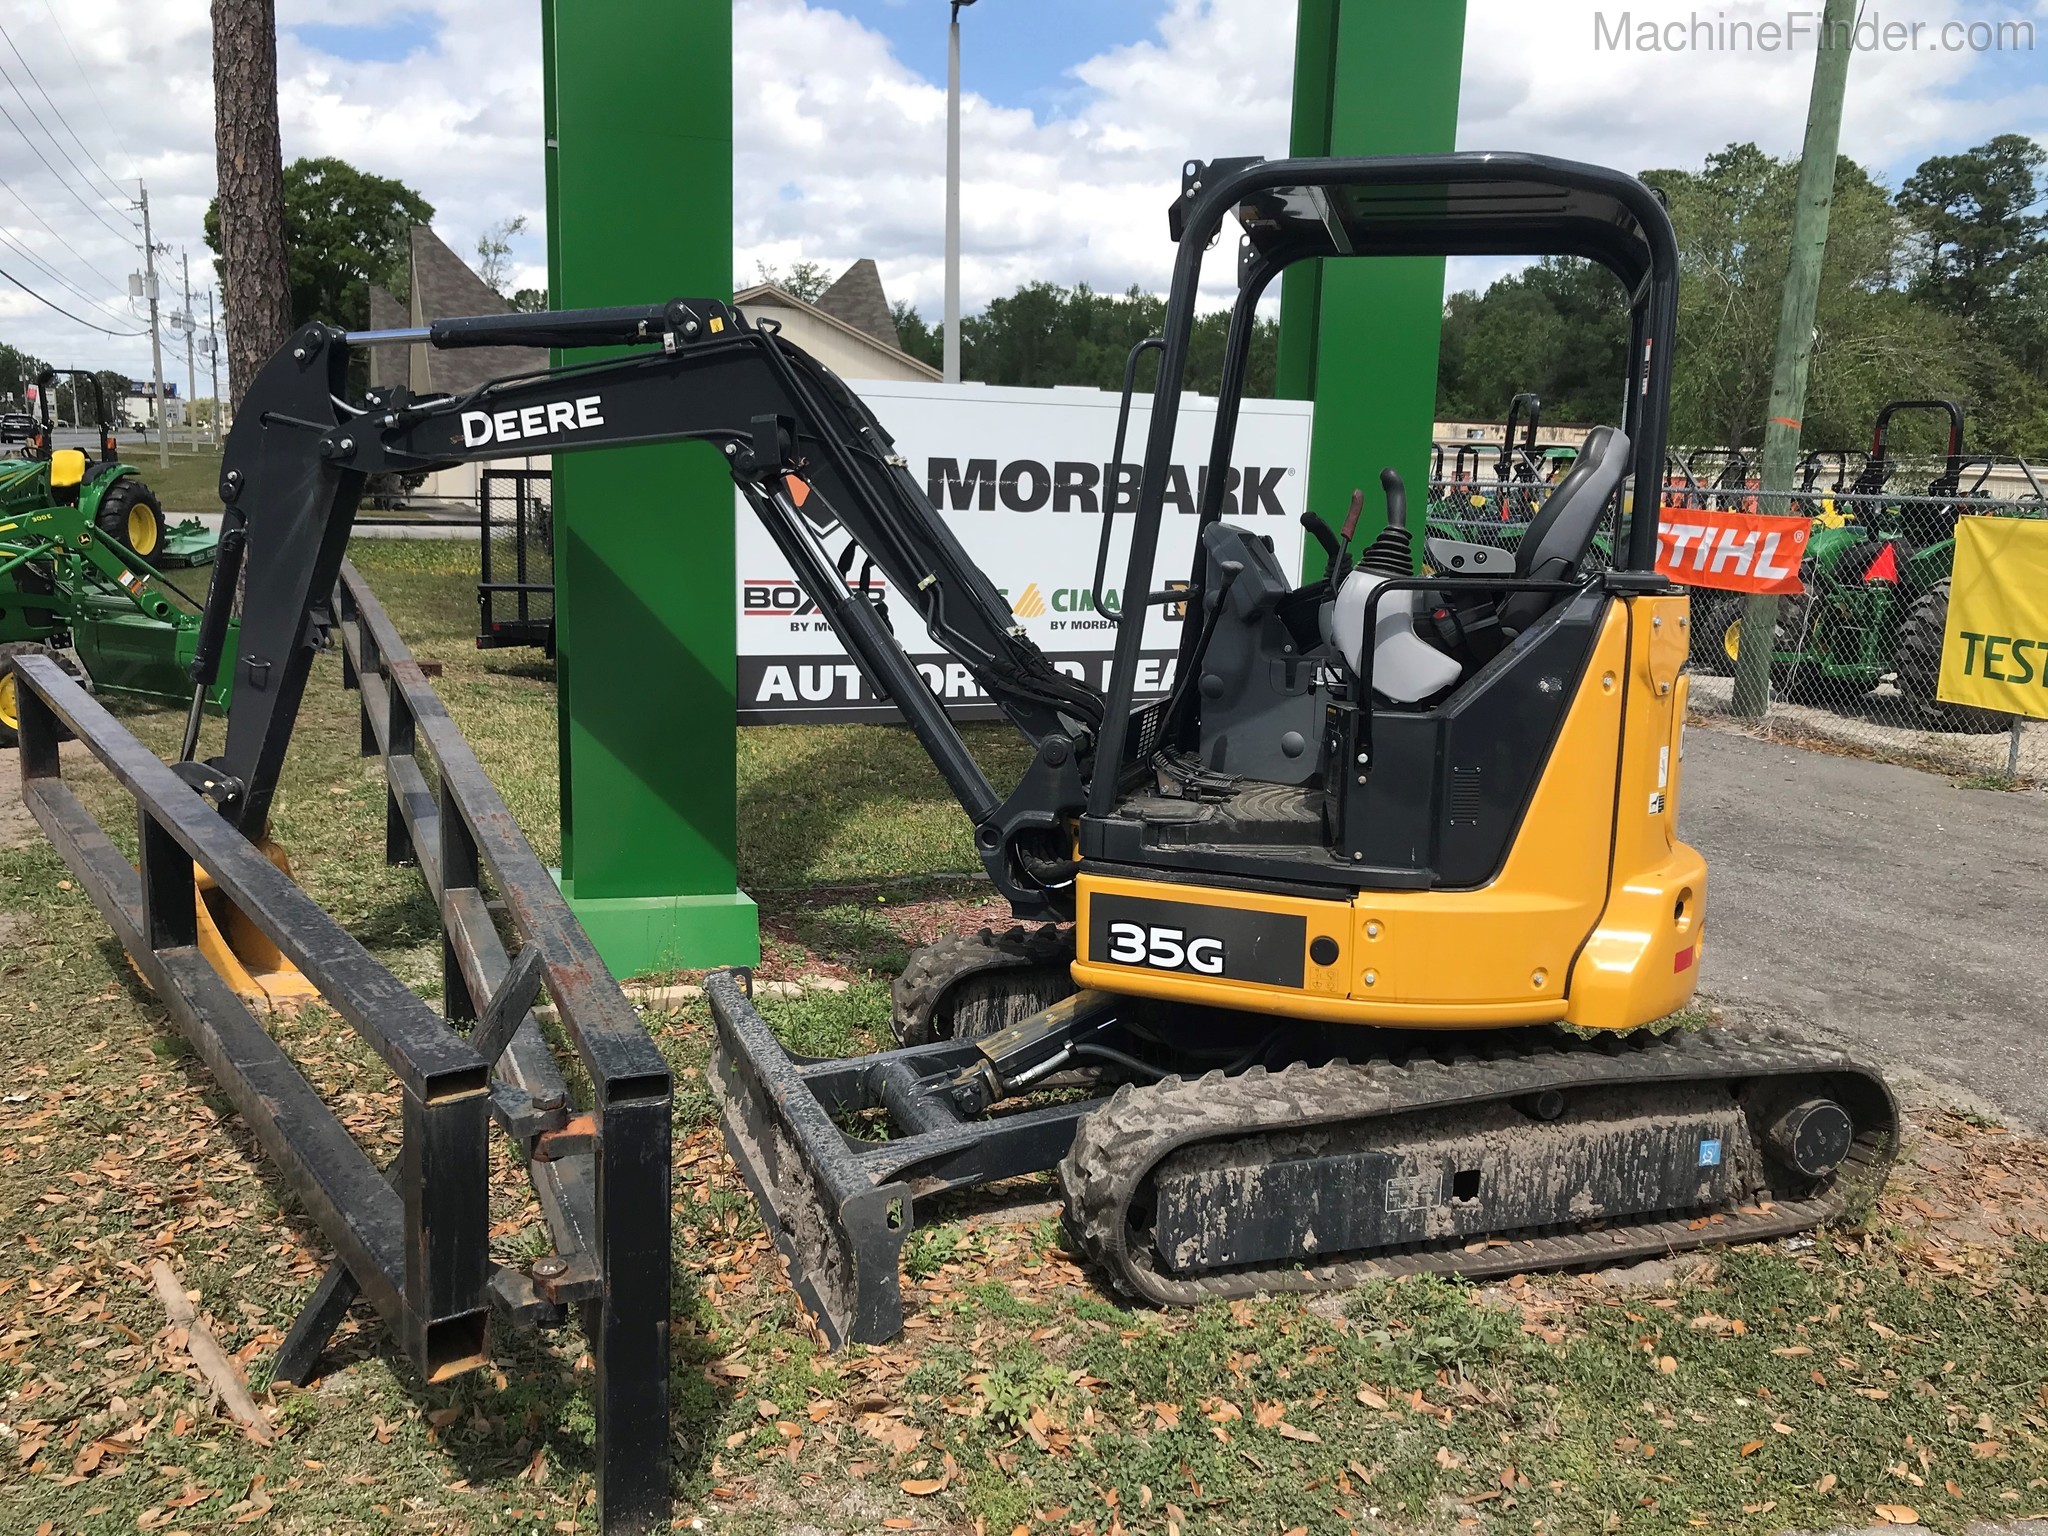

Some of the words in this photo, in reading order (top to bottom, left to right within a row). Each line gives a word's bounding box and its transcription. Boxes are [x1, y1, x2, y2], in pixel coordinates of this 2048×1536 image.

[461, 395, 604, 448] DEERE
[1051, 588, 1124, 612] CIMA
[790, 622, 809, 632] BY
[1050, 621, 1067, 630] BY
[1071, 620, 1119, 630] MORBA
[1109, 922, 1223, 974] 35G
